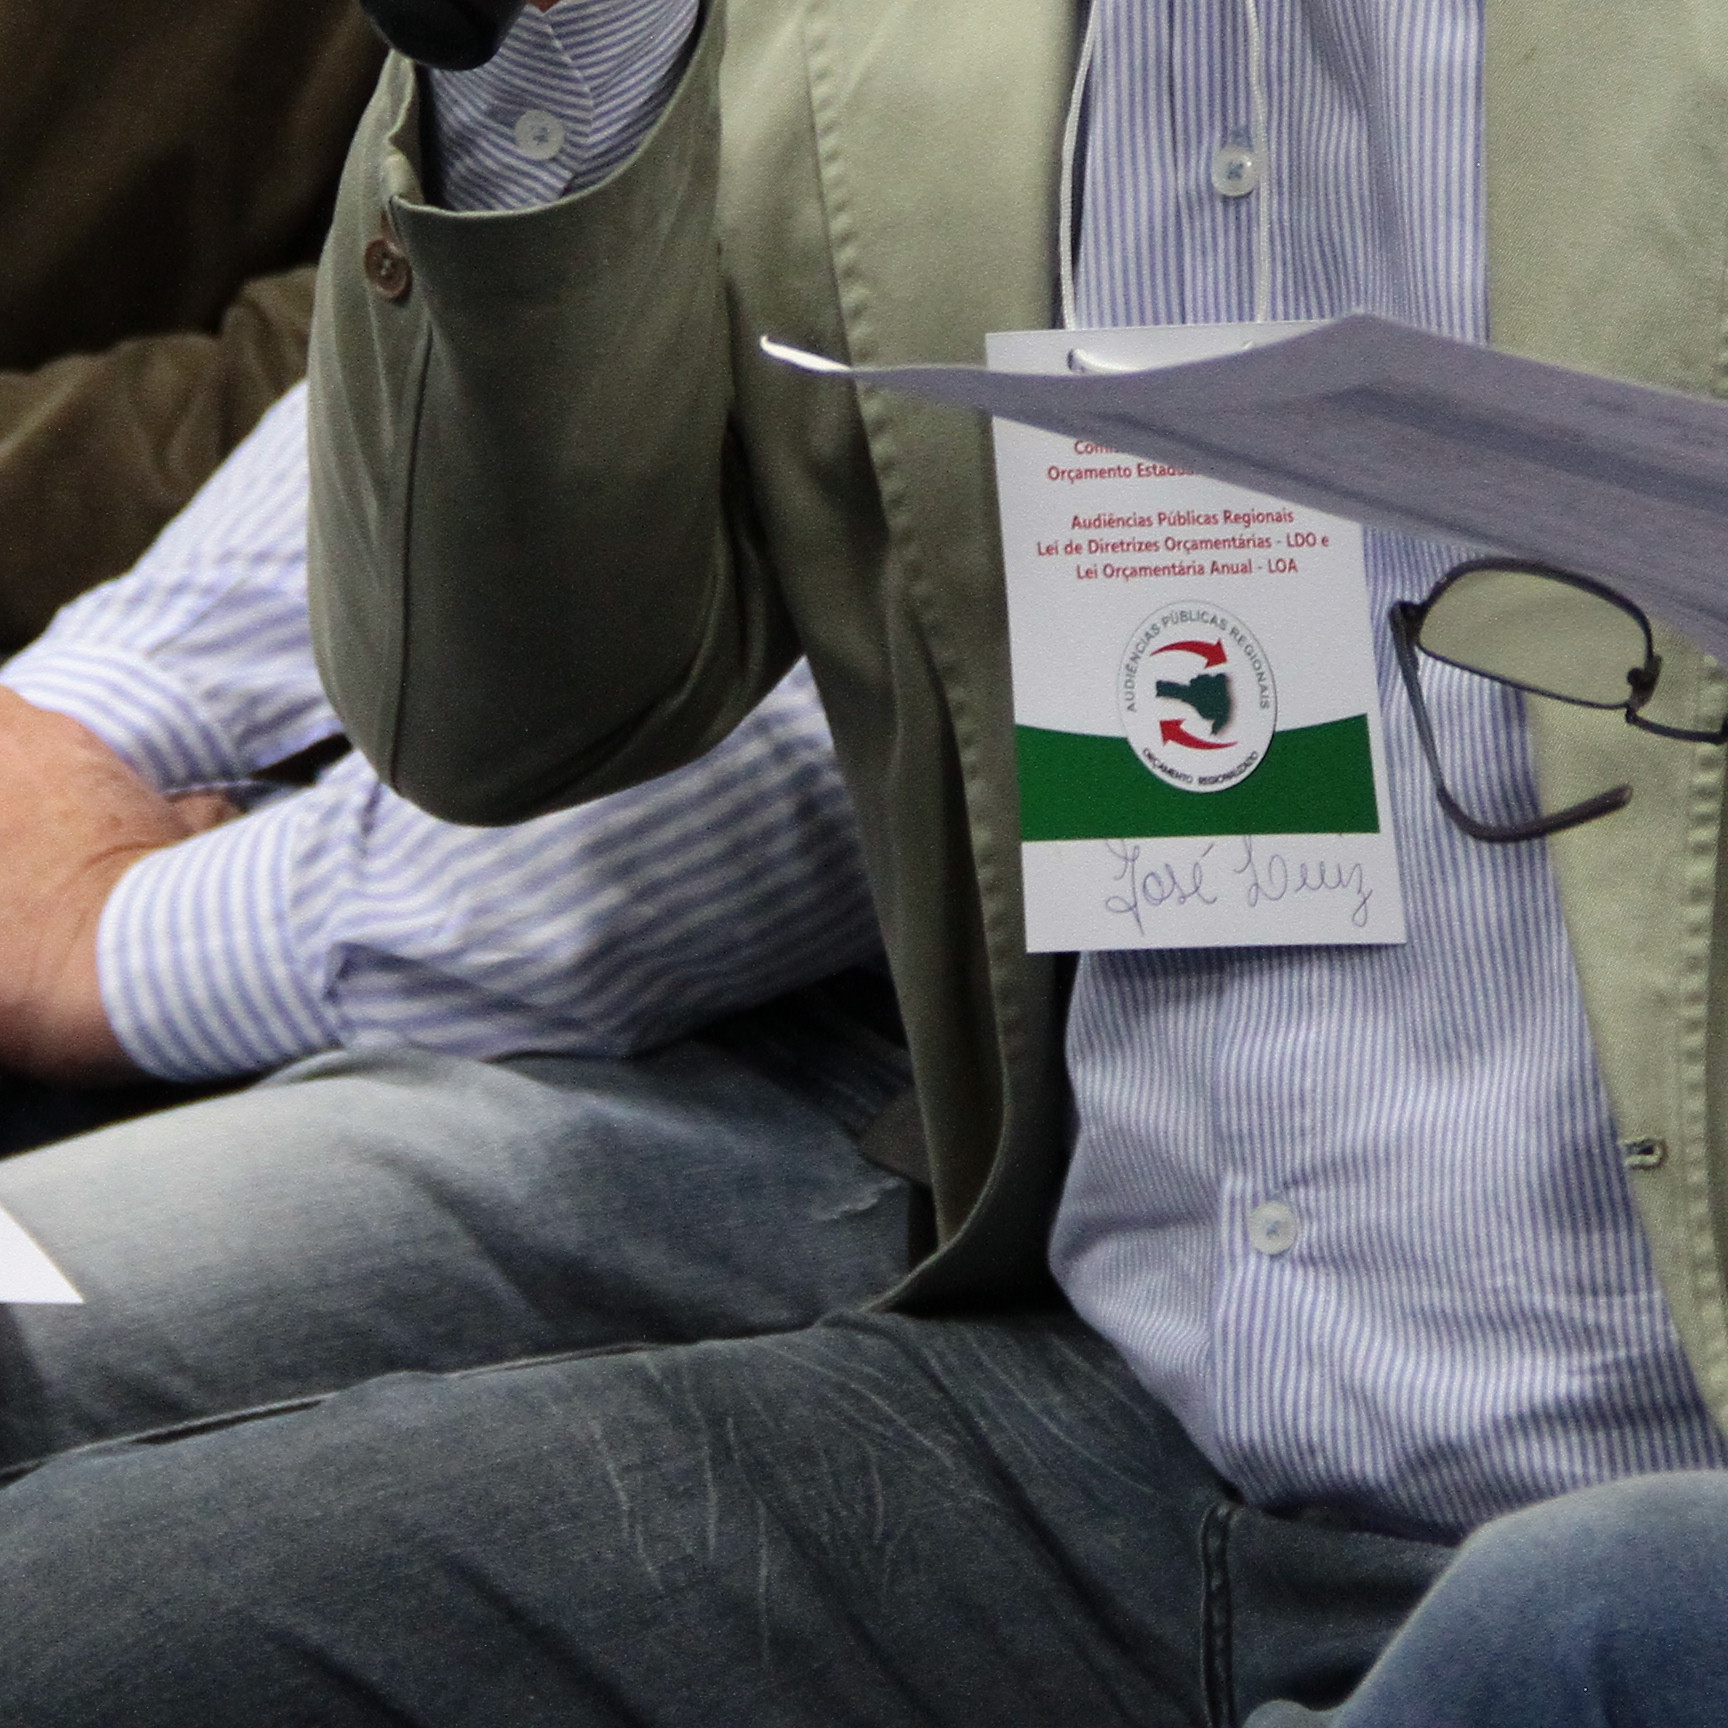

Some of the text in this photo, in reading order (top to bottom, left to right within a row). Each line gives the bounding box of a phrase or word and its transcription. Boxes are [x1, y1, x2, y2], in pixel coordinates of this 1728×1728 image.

[1047, 464, 1132, 484] Orçamento
[1071, 507, 1295, 530] Audiências Públicas Regionais
[1037, 540, 1059, 556] Lei
[1064, 539, 1083, 555] de
[1088, 536, 1161, 555] Diretrizes
[1164, 533, 1272, 555] Orçamentárias
[1286, 532, 1317, 548] LDO
[1321, 534, 1330, 548] e
[1076, 564, 1098, 580] Lei
[1103, 560, 1205, 582] Orçamentária
[1209, 558, 1253, 576] Anual
[1267, 557, 1299, 574] LOA
[1124, 623, 1160, 713] AUDIÊNCIAS
[1230, 626, 1270, 710] REGIONAIS
